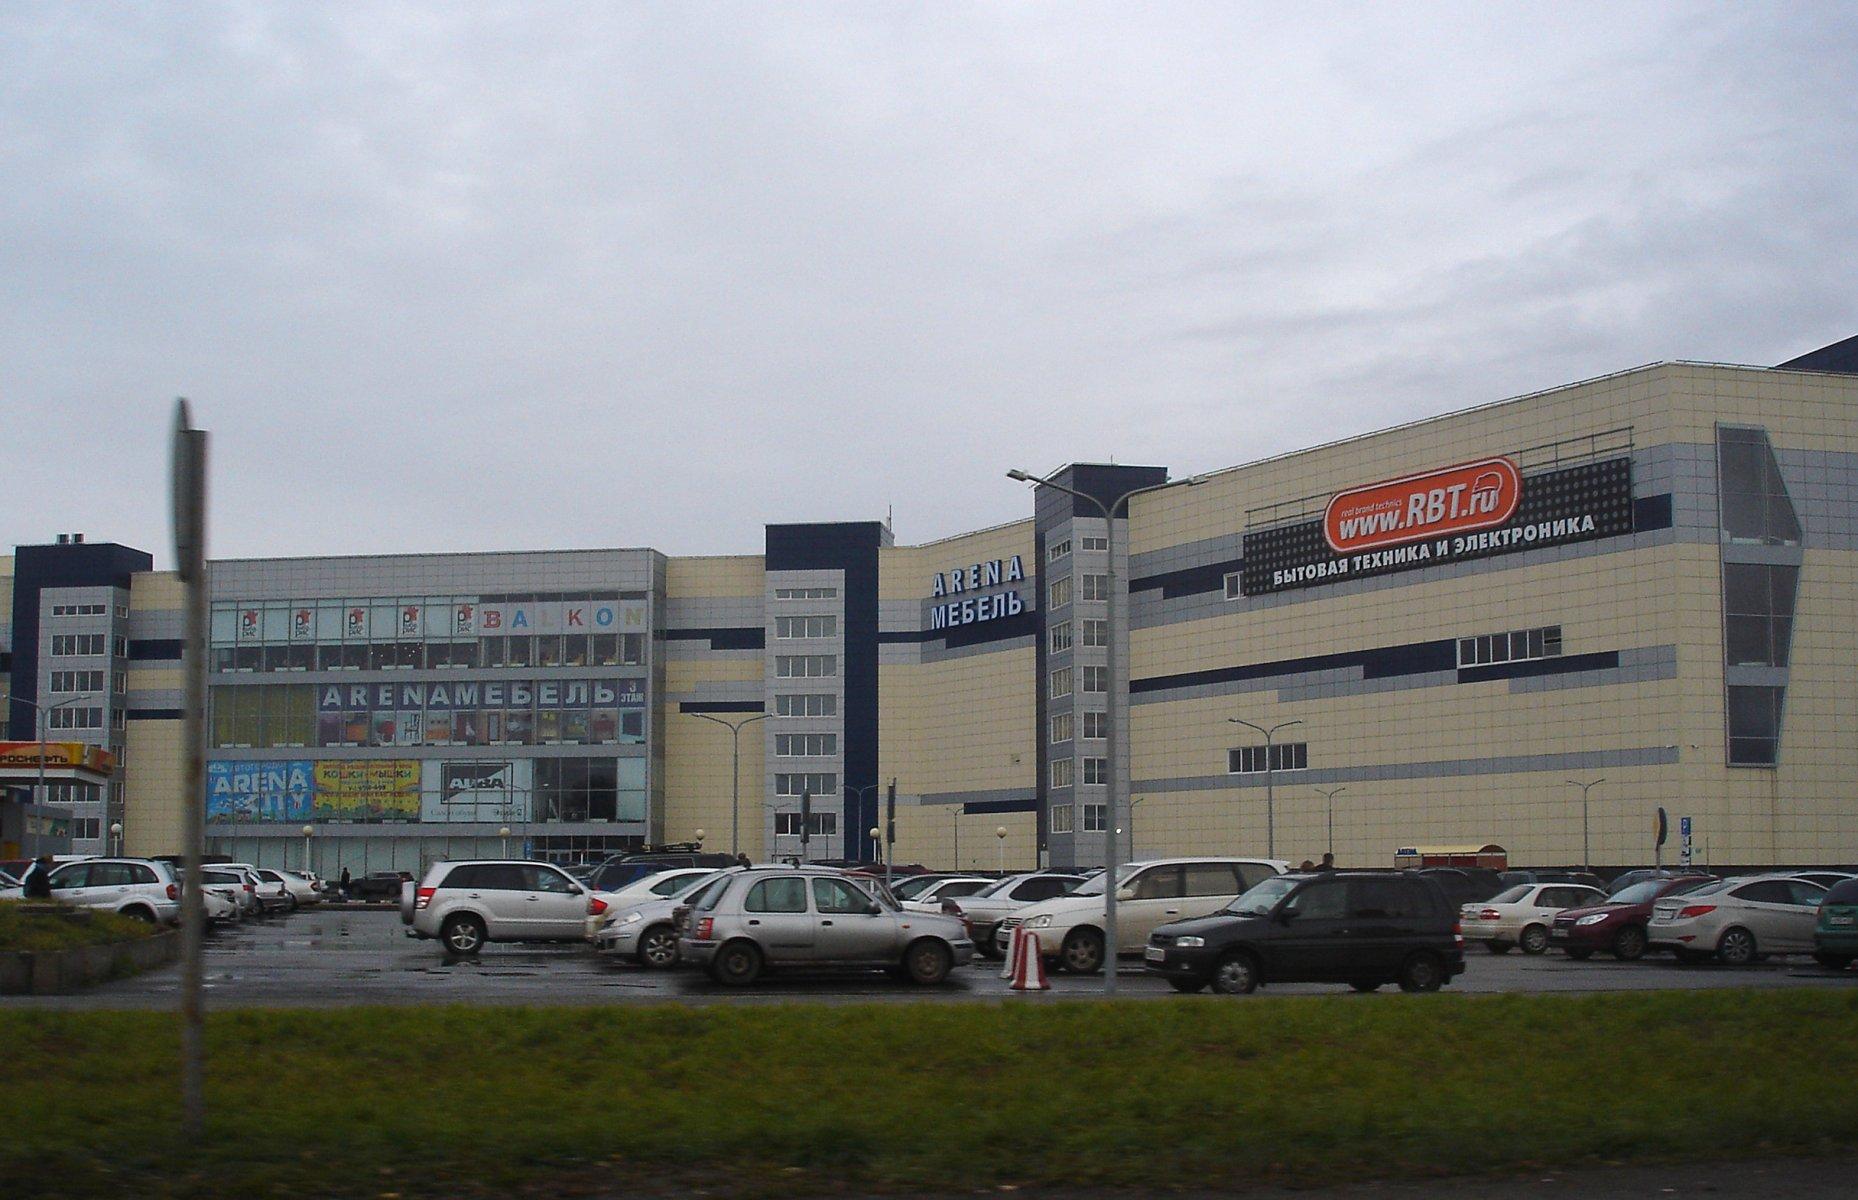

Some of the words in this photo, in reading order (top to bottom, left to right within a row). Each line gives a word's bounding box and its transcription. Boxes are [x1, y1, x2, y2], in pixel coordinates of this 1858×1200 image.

[1339, 483, 1499, 540] www.RBT.ru
[1273, 559, 1348, 586] БЫТОВАЯ
[1353, 544, 1429, 573] ТЕХНИКА
[1437, 538, 1449, 556] И
[1454, 515, 1595, 555] ЭЛЕКТРОНИКА
[932, 555, 1022, 597] ARENA
[483, 607, 644, 629] BALKON
[931, 591, 1023, 630] МЕБЕЛЬ
